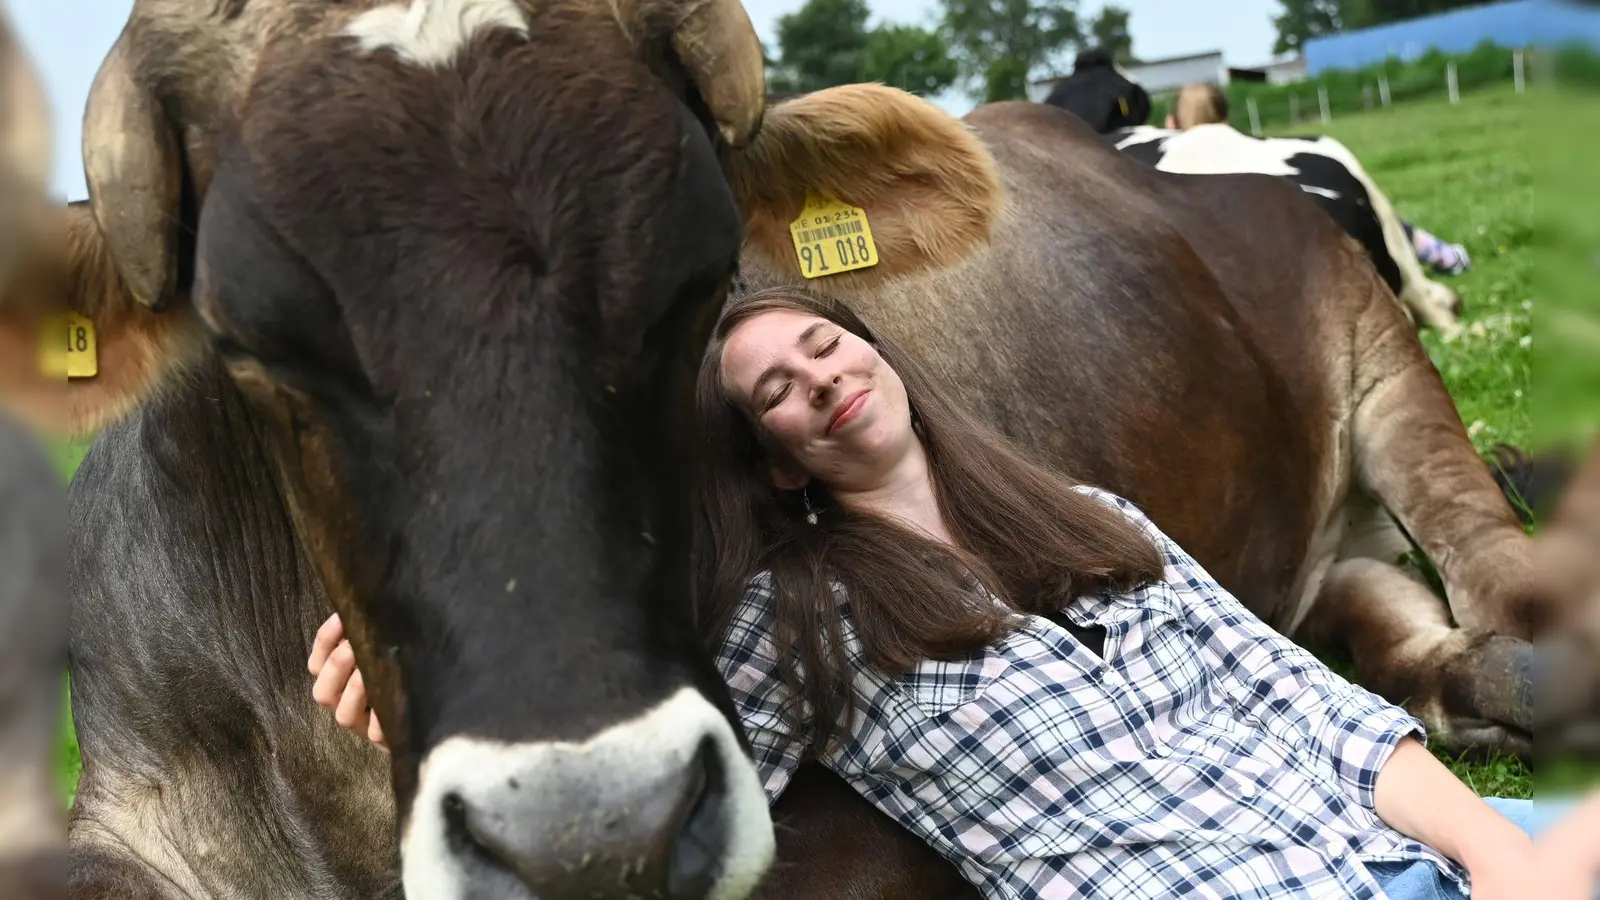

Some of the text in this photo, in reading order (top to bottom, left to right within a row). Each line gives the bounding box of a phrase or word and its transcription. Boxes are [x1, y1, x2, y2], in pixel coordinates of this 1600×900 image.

[814, 215, 830, 225] 01
[801, 235, 869, 273] 91 018
